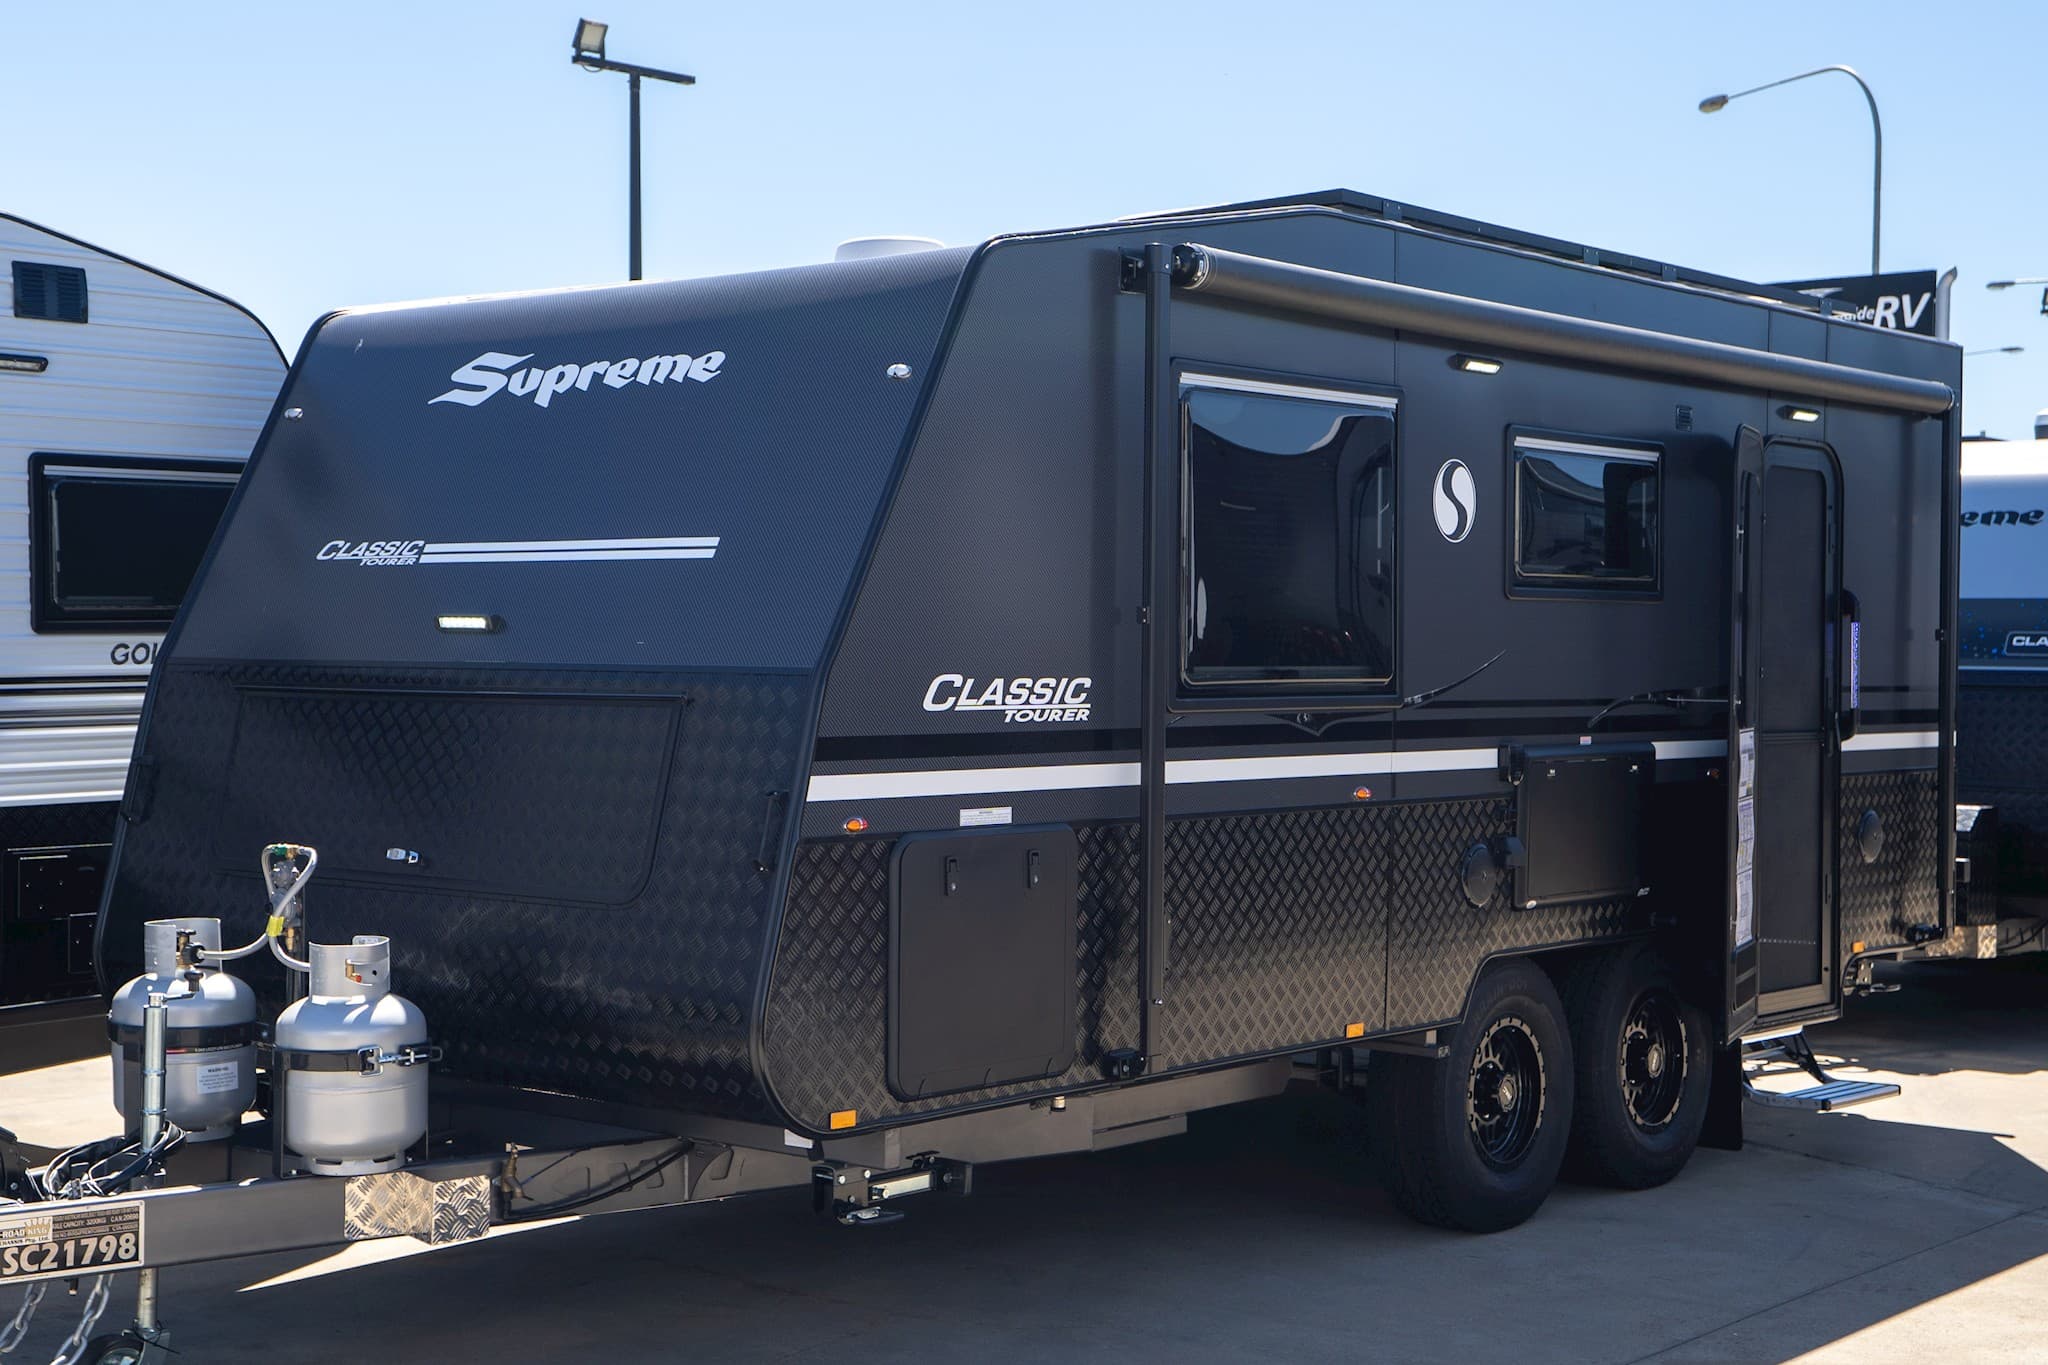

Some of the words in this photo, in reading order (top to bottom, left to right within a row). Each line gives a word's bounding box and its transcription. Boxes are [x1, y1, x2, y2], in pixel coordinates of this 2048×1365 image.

[427, 350, 726, 408] Supreme
[316, 540, 425, 561] CLASSIC
[360, 557, 417, 567] TOURER
[922, 673, 1092, 712] CLASSIC
[1004, 708, 1090, 723] TOURER
[2, 1232, 137, 1276] SC21798
